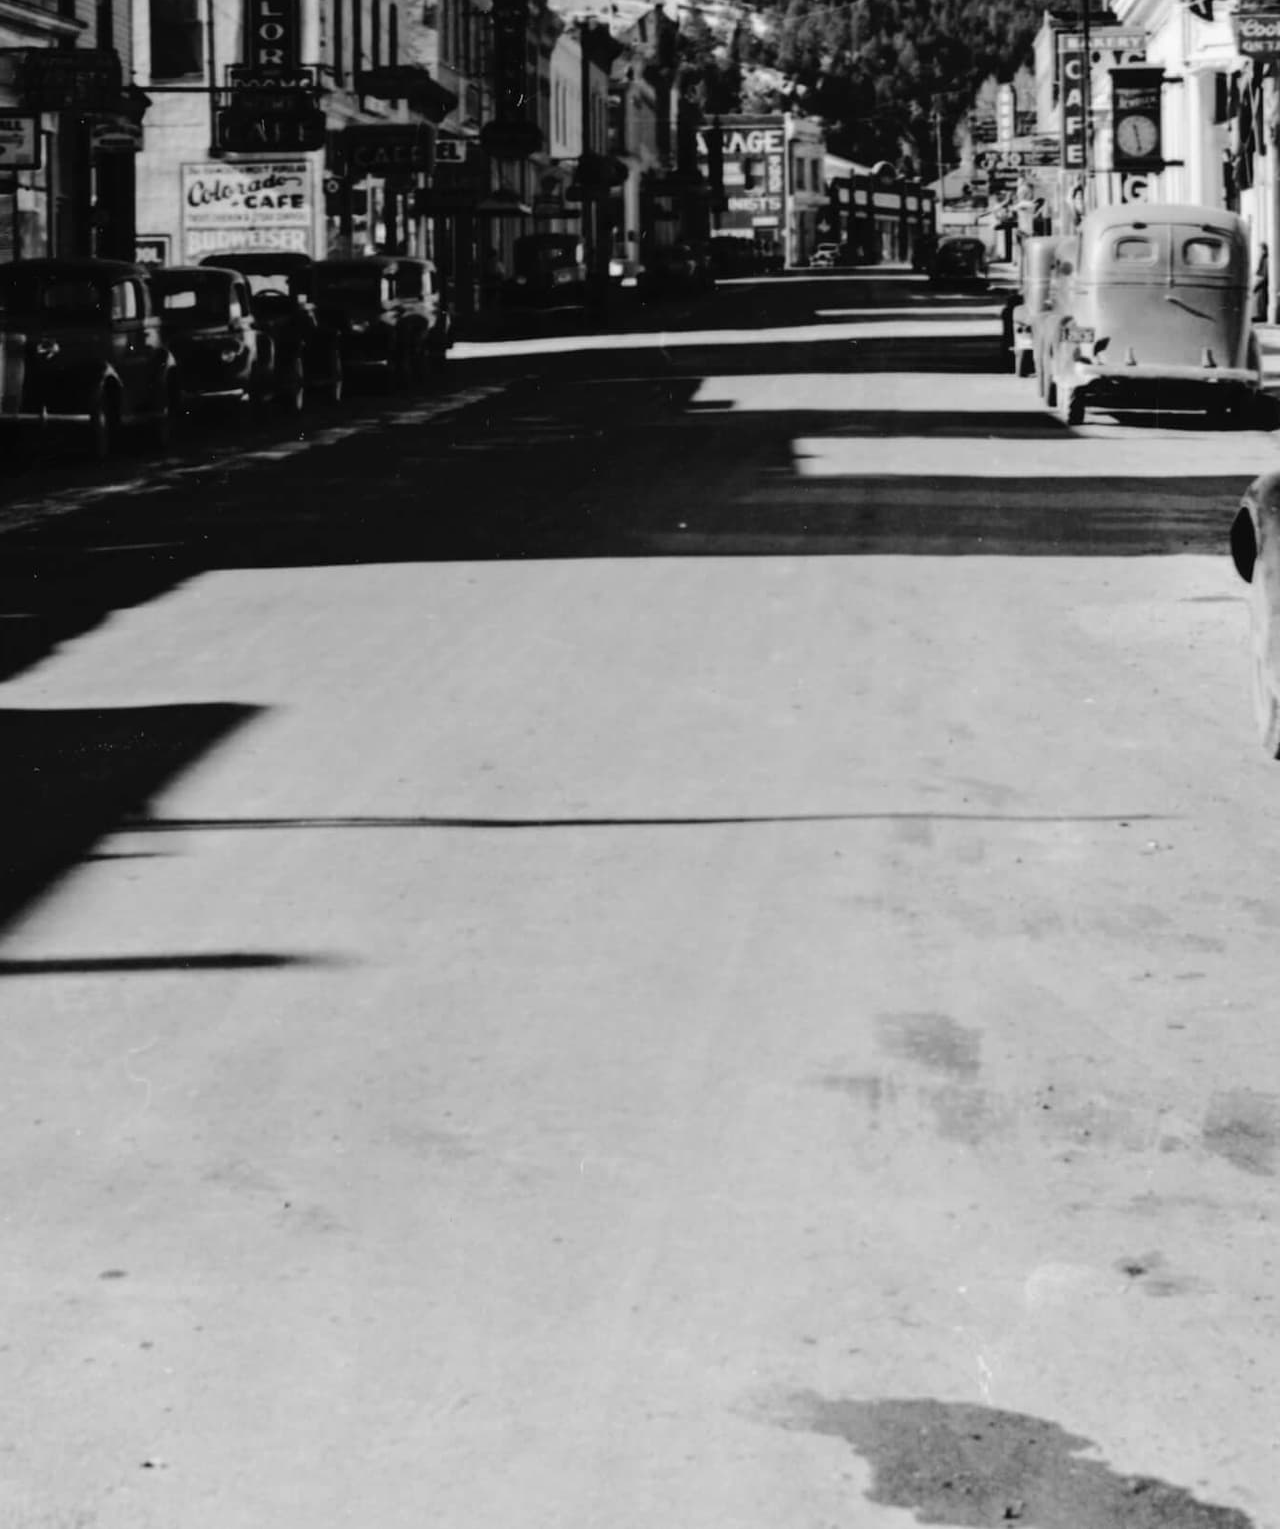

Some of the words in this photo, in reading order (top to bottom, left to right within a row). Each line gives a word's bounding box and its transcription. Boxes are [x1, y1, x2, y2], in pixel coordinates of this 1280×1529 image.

[1065, 58, 1084, 163] CAFE
[187, 174, 303, 207] Colorado
[244, 194, 305, 209] CAFE
